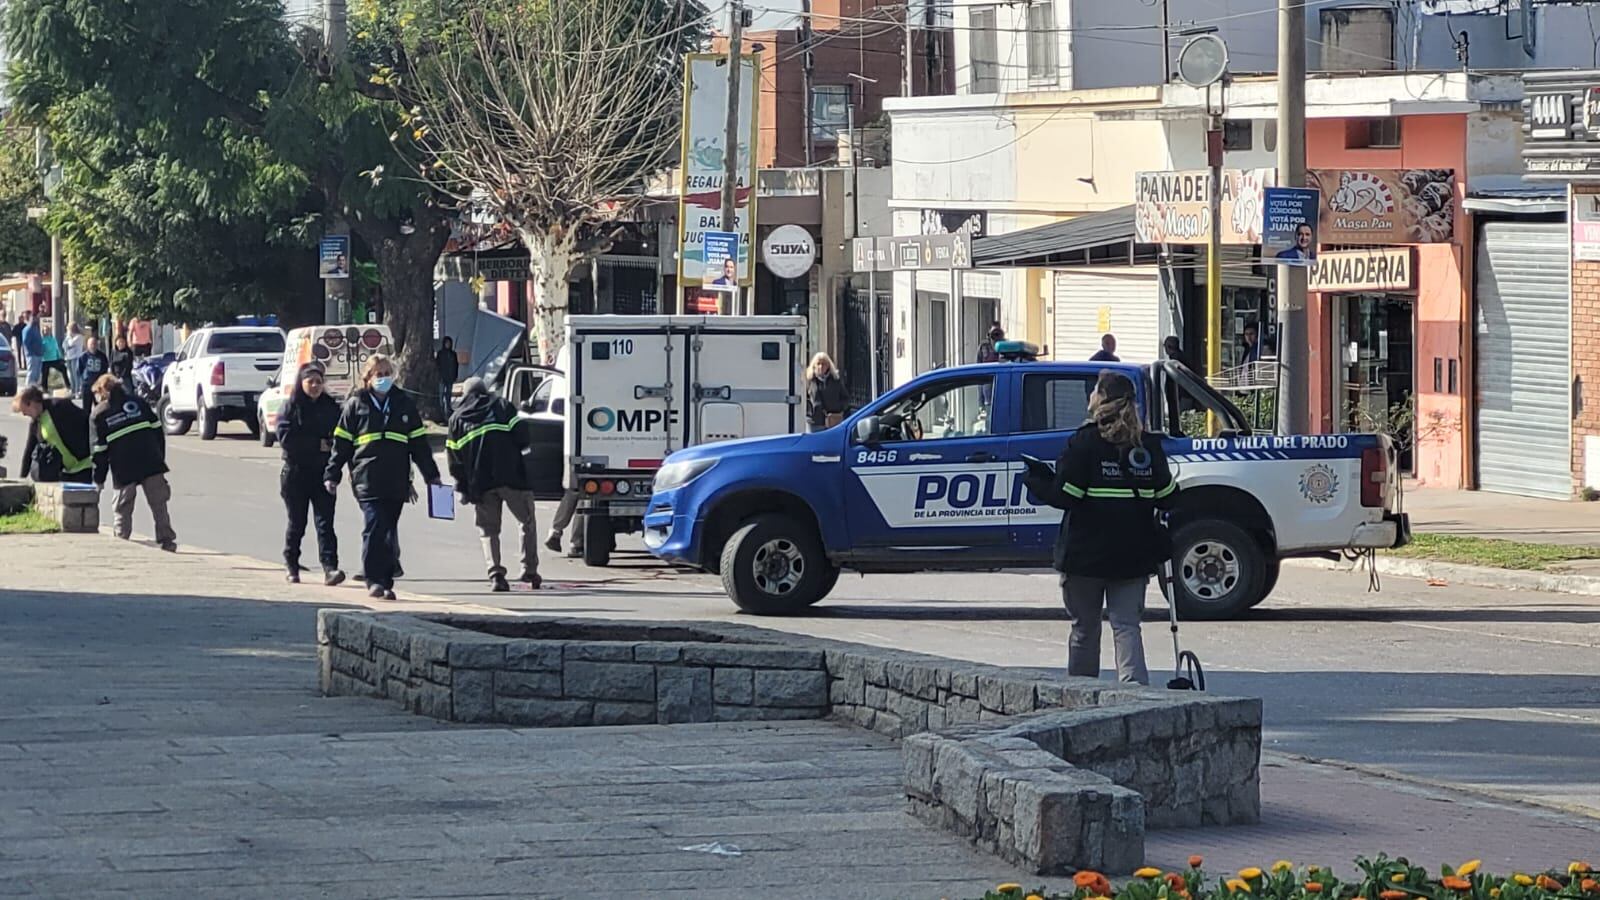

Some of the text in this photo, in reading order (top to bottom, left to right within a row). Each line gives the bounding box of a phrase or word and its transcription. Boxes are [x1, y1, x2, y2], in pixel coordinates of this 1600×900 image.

[1140, 175, 1232, 202] PANADEA
[700, 216, 740, 228] BAZR
[1269, 223, 1298, 232] JUAN
[1333, 218, 1392, 231] Masa Pan
[478, 258, 529, 270] HERBORI
[1308, 255, 1406, 286] PANADERIA
[491, 269, 529, 279] DIETET
[612, 339, 633, 355] 110
[1192, 435, 1348, 450] DTTO VILLA DEL PRADO
[857, 450, 898, 463] 8456
[915, 473, 1051, 510] POLI
[926, 510, 937, 518] LA
[938, 509, 983, 518] PROVINCIA
[985, 508, 996, 516] DE
